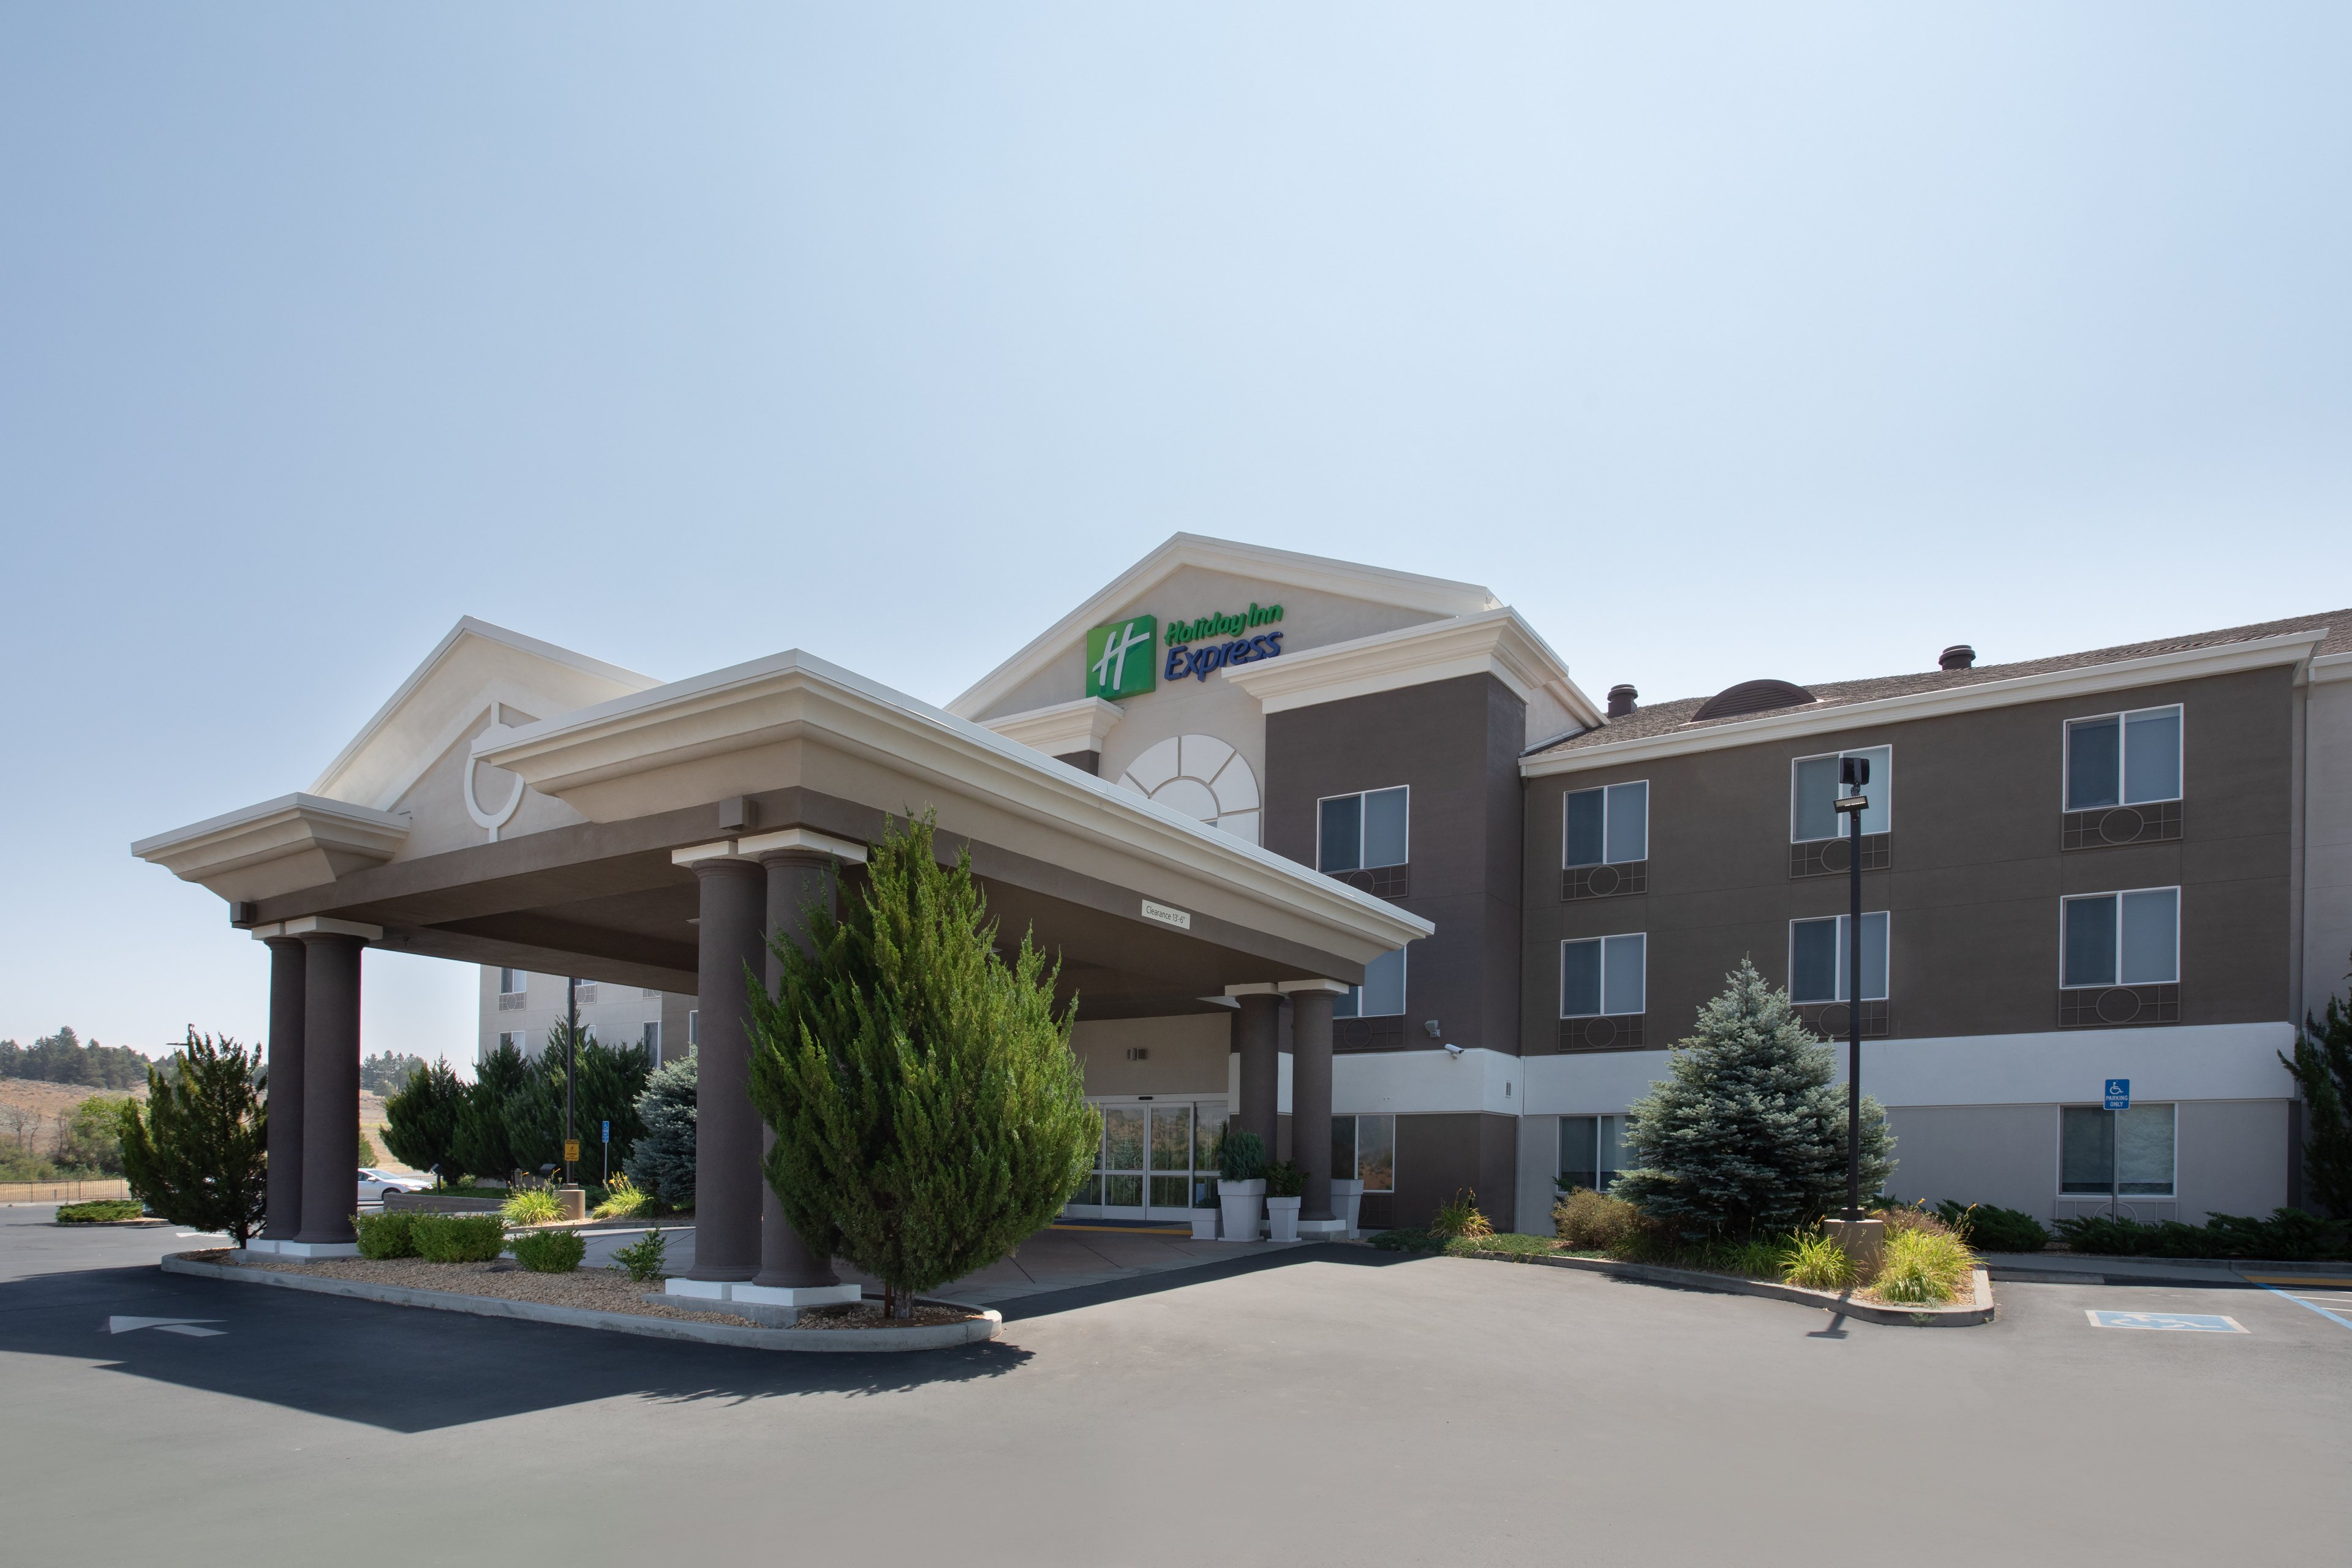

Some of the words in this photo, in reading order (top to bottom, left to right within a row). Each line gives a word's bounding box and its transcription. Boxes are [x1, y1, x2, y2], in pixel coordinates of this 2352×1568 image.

[1164, 611, 1247, 646] Holiday
[1247, 603, 1283, 628] Inn
[1092, 622, 1150, 690] H
[1164, 631, 1283, 682] Express
[1146, 905, 1171, 920] Clearance
